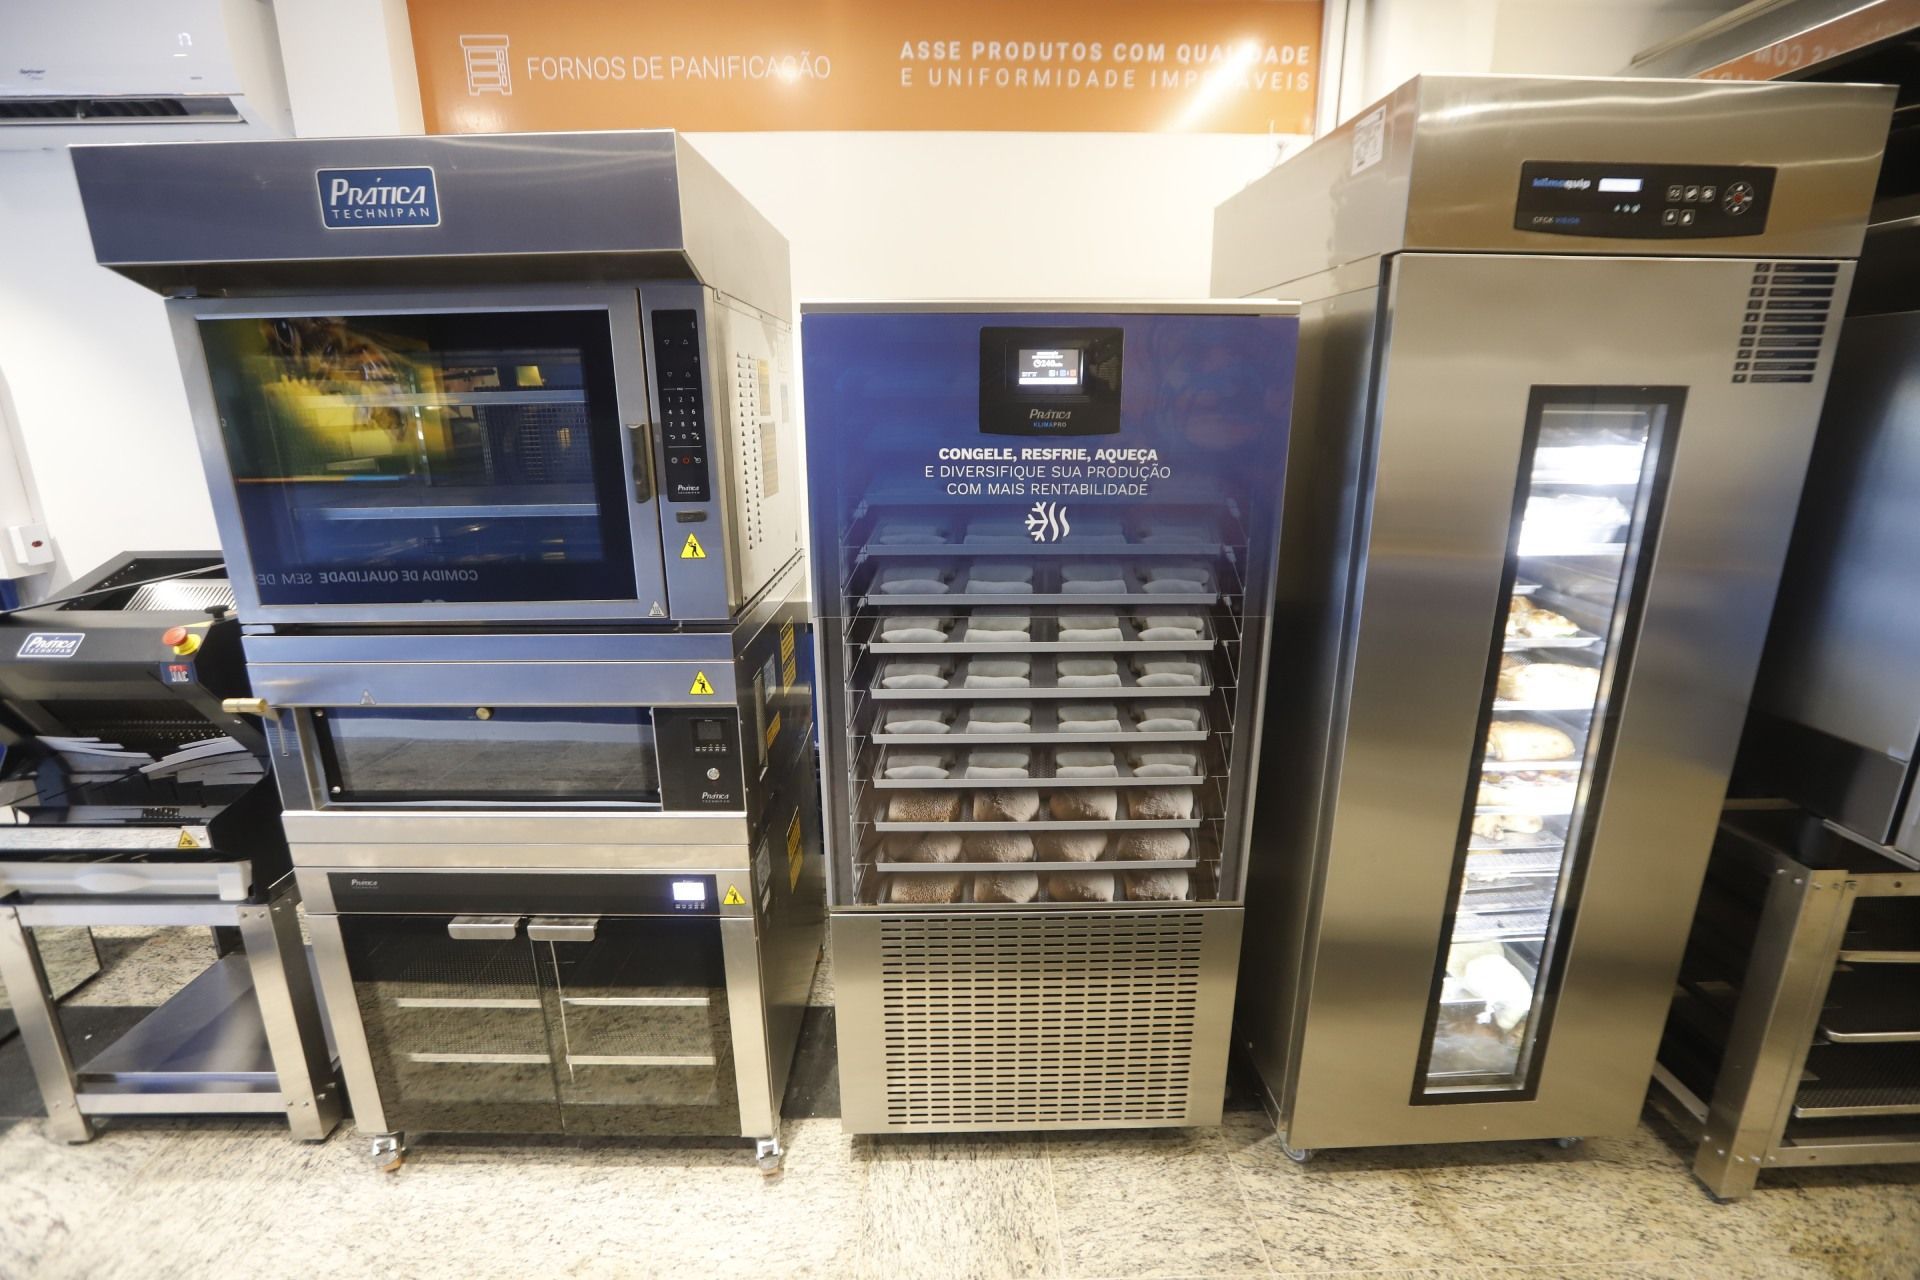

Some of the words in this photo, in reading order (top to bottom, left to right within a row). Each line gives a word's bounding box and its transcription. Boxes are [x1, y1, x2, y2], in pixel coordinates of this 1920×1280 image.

[900, 41, 961, 60] ASSE
[972, 42, 1103, 62] PRODUTOS
[1113, 43, 1165, 63] COM
[1176, 44, 1311, 66] QUADADE
[527, 56, 626, 81] FORNOS
[633, 56, 664, 80] DE
[671, 51, 831, 83] PANIFICAÇÃO
[901, 68, 913, 87] E
[929, 67, 1136, 88] UNIFORMIDADE
[1151, 69, 1310, 91] IMPVEIS
[331, 207, 430, 219] TECHNIPAN
[938, 448, 1018, 462] CONGELE,
[1021, 448, 1092, 462] RESFRIE,
[1095, 448, 1158, 463] AQUEÇA
[925, 465, 934, 478] E
[940, 465, 1046, 480] DIVERSIFIQUE
[1051, 465, 1082, 478] SUA
[1087, 463, 1171, 482] PRODUÇÃO
[947, 483, 982, 495] COM
[988, 483, 1025, 495] MAIS
[1031, 483, 1148, 495] RENTABILIDADE
